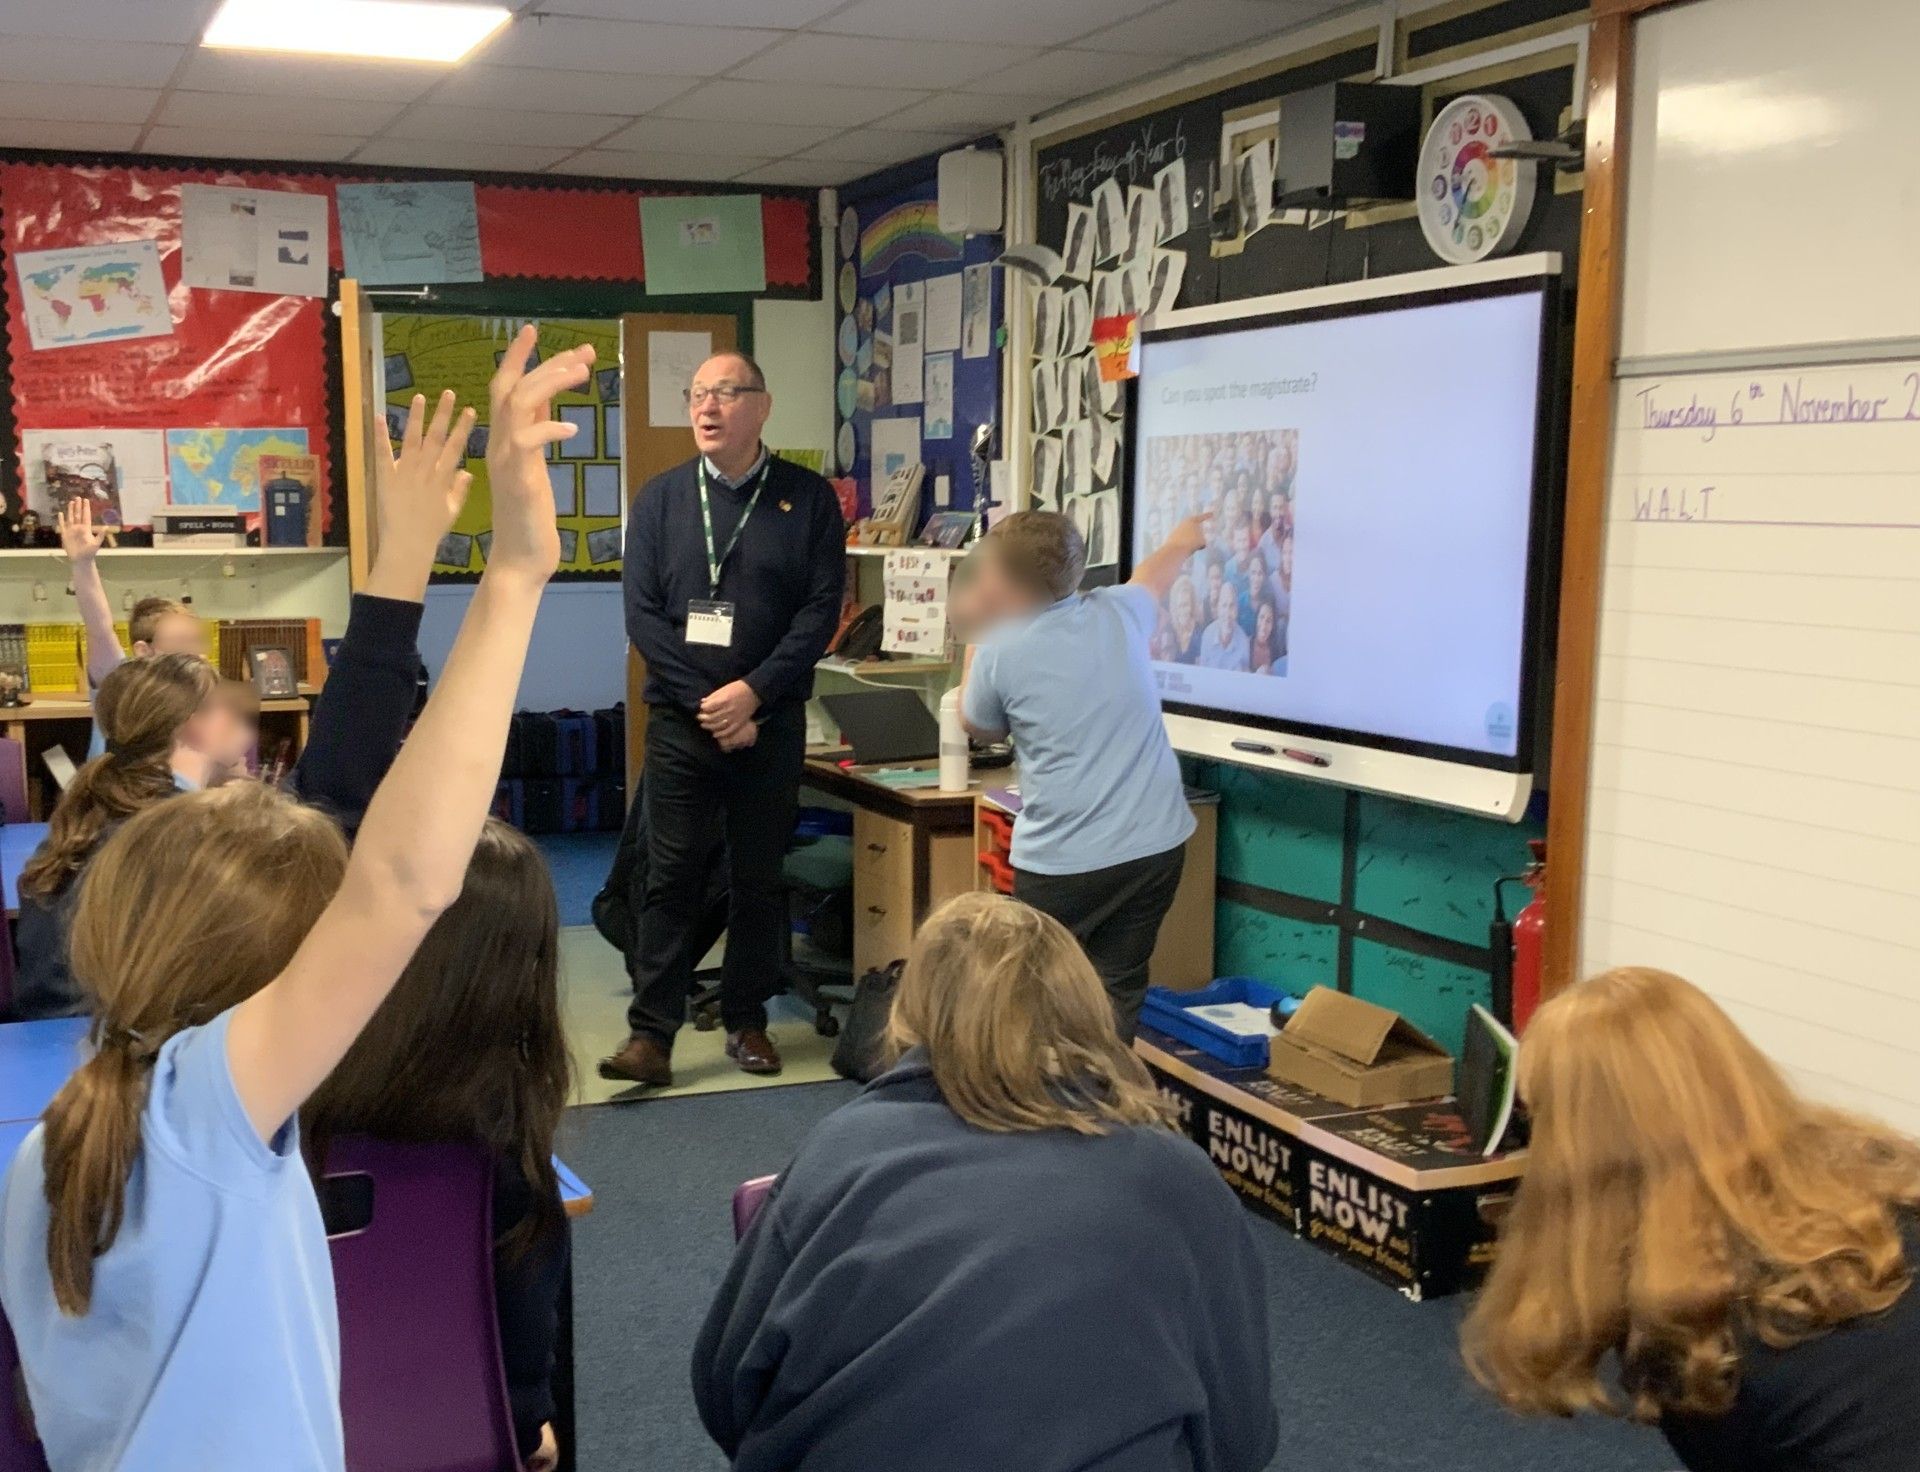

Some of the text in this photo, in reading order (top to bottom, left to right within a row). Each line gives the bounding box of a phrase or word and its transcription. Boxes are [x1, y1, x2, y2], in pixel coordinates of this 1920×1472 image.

[1175, 117, 1187, 157] 6
[1161, 371, 1319, 407] Can you spot the magistrate?
[1635, 384, 1717, 442] Thursday
[1779, 376, 1889, 423] November
[1208, 1109, 1292, 1173] ENLIST
[1209, 1136, 1277, 1186] NOW
[1309, 1160, 1409, 1229] ENLIST
[1309, 1189, 1390, 1244] NOW
